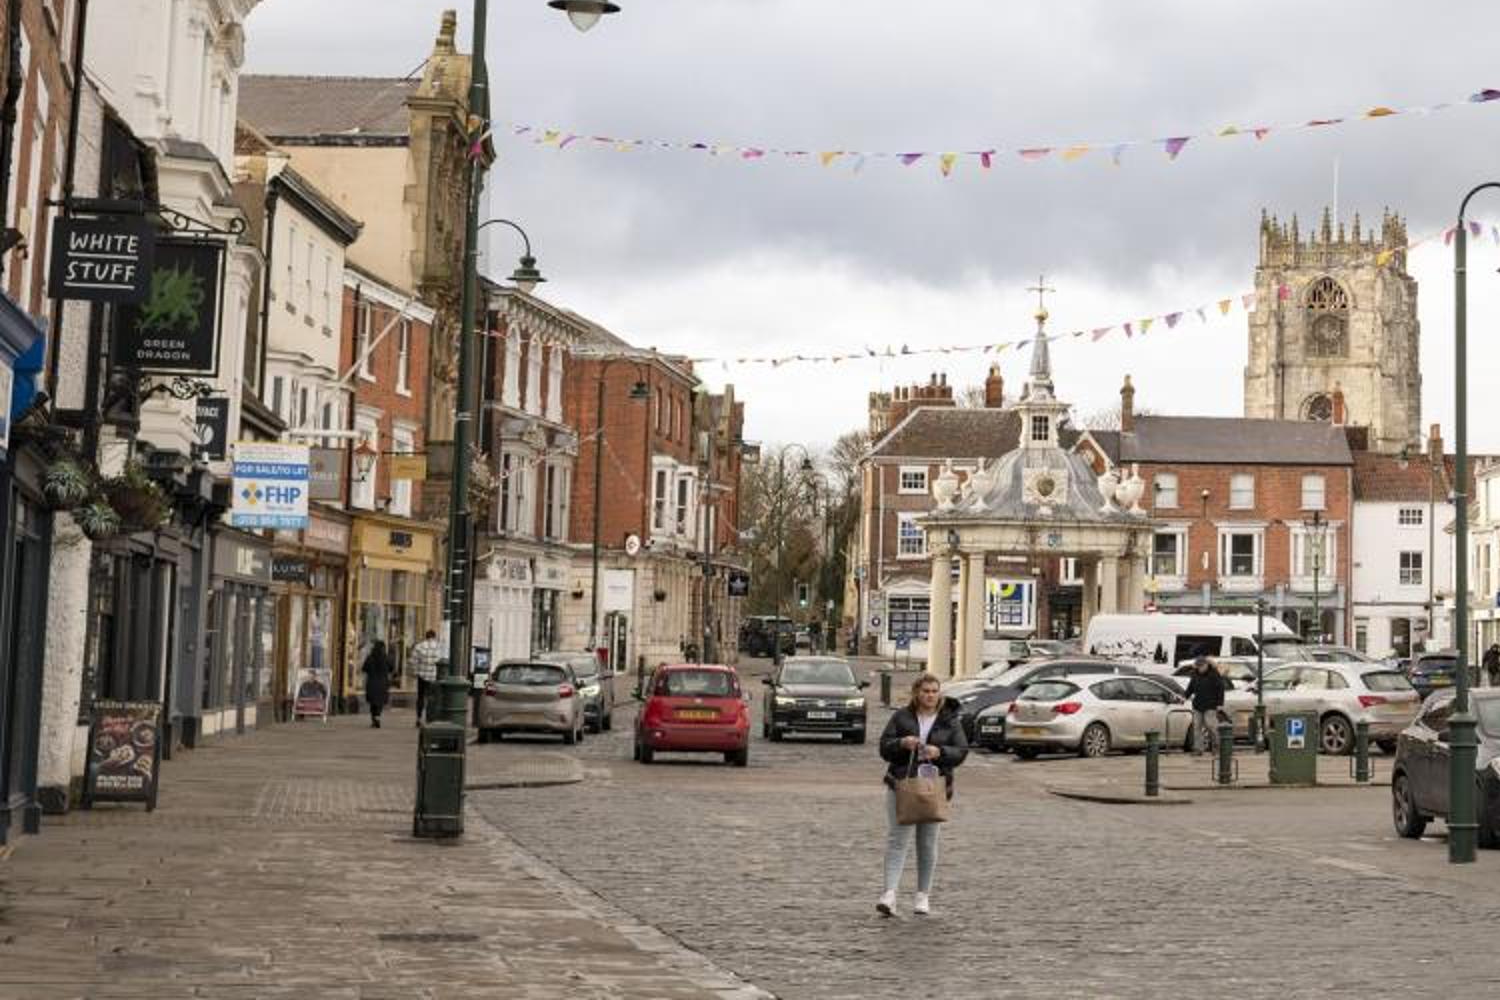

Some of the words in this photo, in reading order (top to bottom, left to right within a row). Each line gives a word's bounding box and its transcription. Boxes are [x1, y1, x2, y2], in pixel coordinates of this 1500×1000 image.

[69, 232, 139, 253] WHITE
[65, 261, 136, 282] STUFF
[143, 339, 185, 349] GREEN
[137, 350, 190, 360] DRAGON
[235, 464, 253, 474] FOR
[265, 486, 301, 504] FHP
[1291, 719, 1303, 736] P
